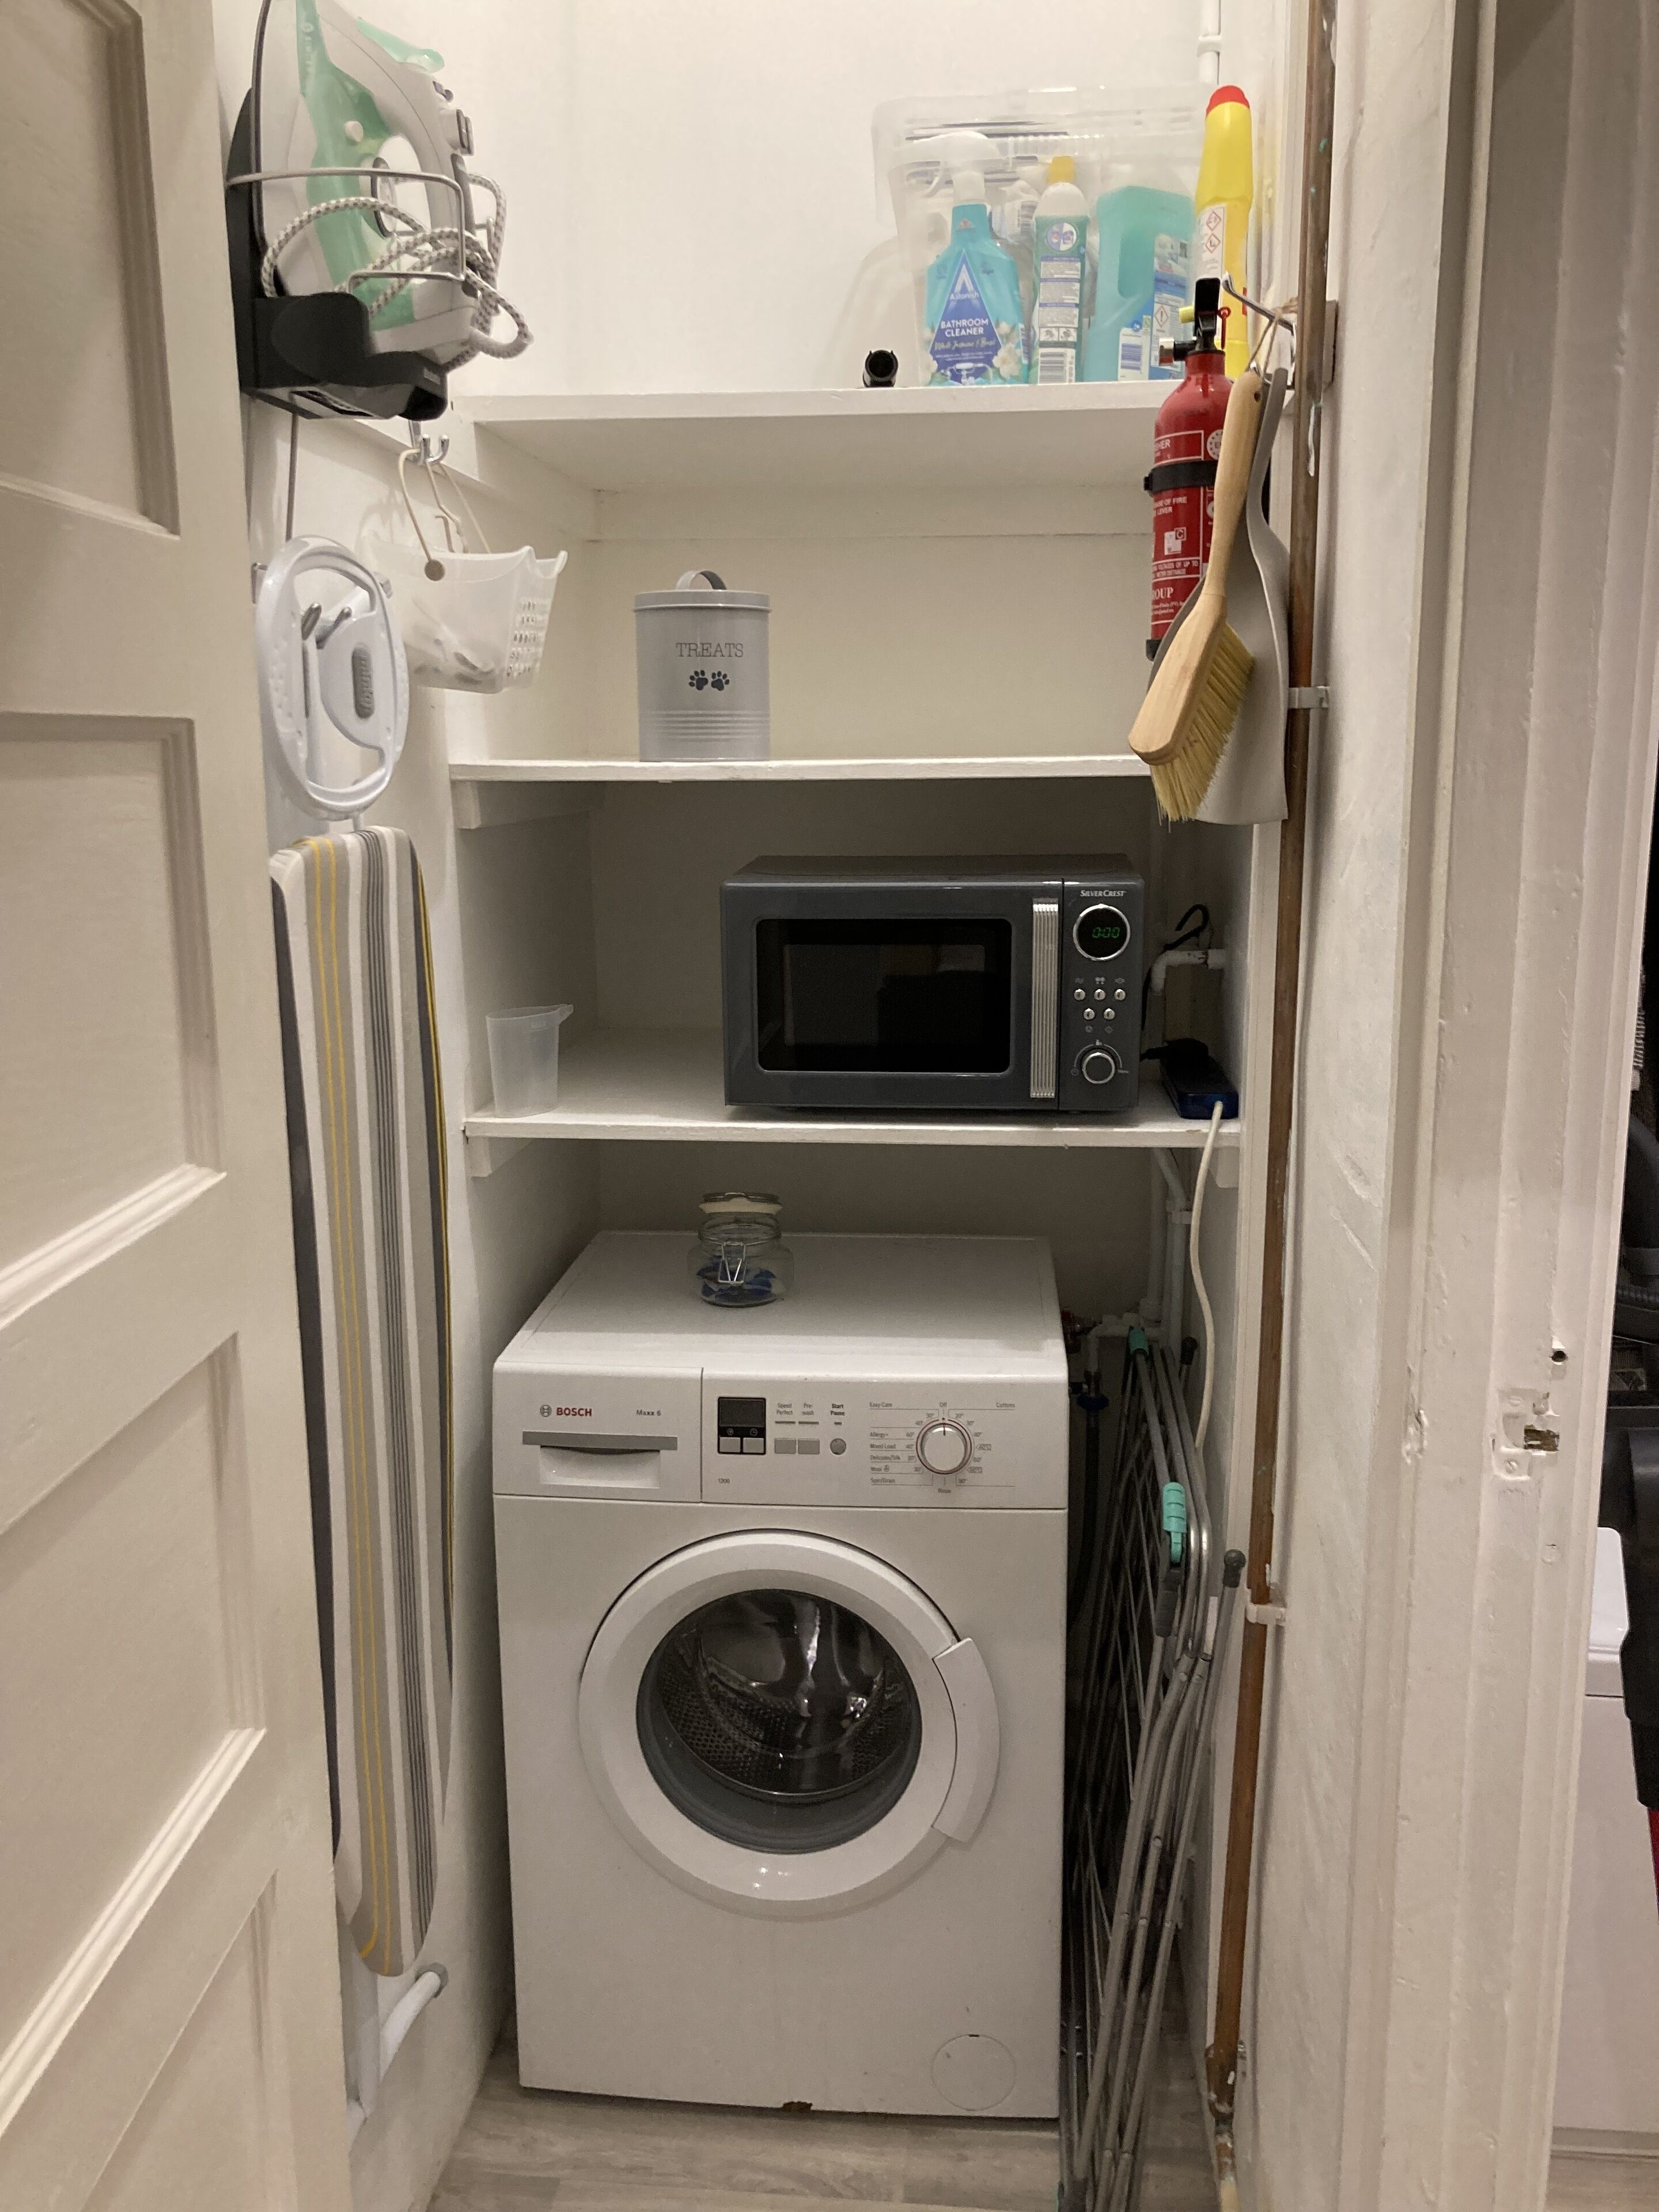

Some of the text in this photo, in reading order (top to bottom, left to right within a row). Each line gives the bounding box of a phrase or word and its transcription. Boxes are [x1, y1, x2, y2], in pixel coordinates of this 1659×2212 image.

[941, 318, 989, 329] BATHROOM
[945, 327, 984, 338] CLEANER
[676, 642, 744, 658] TREATS
[1092, 927, 1120, 939] 0:00
[556, 1407, 592, 1417] BOSCH
